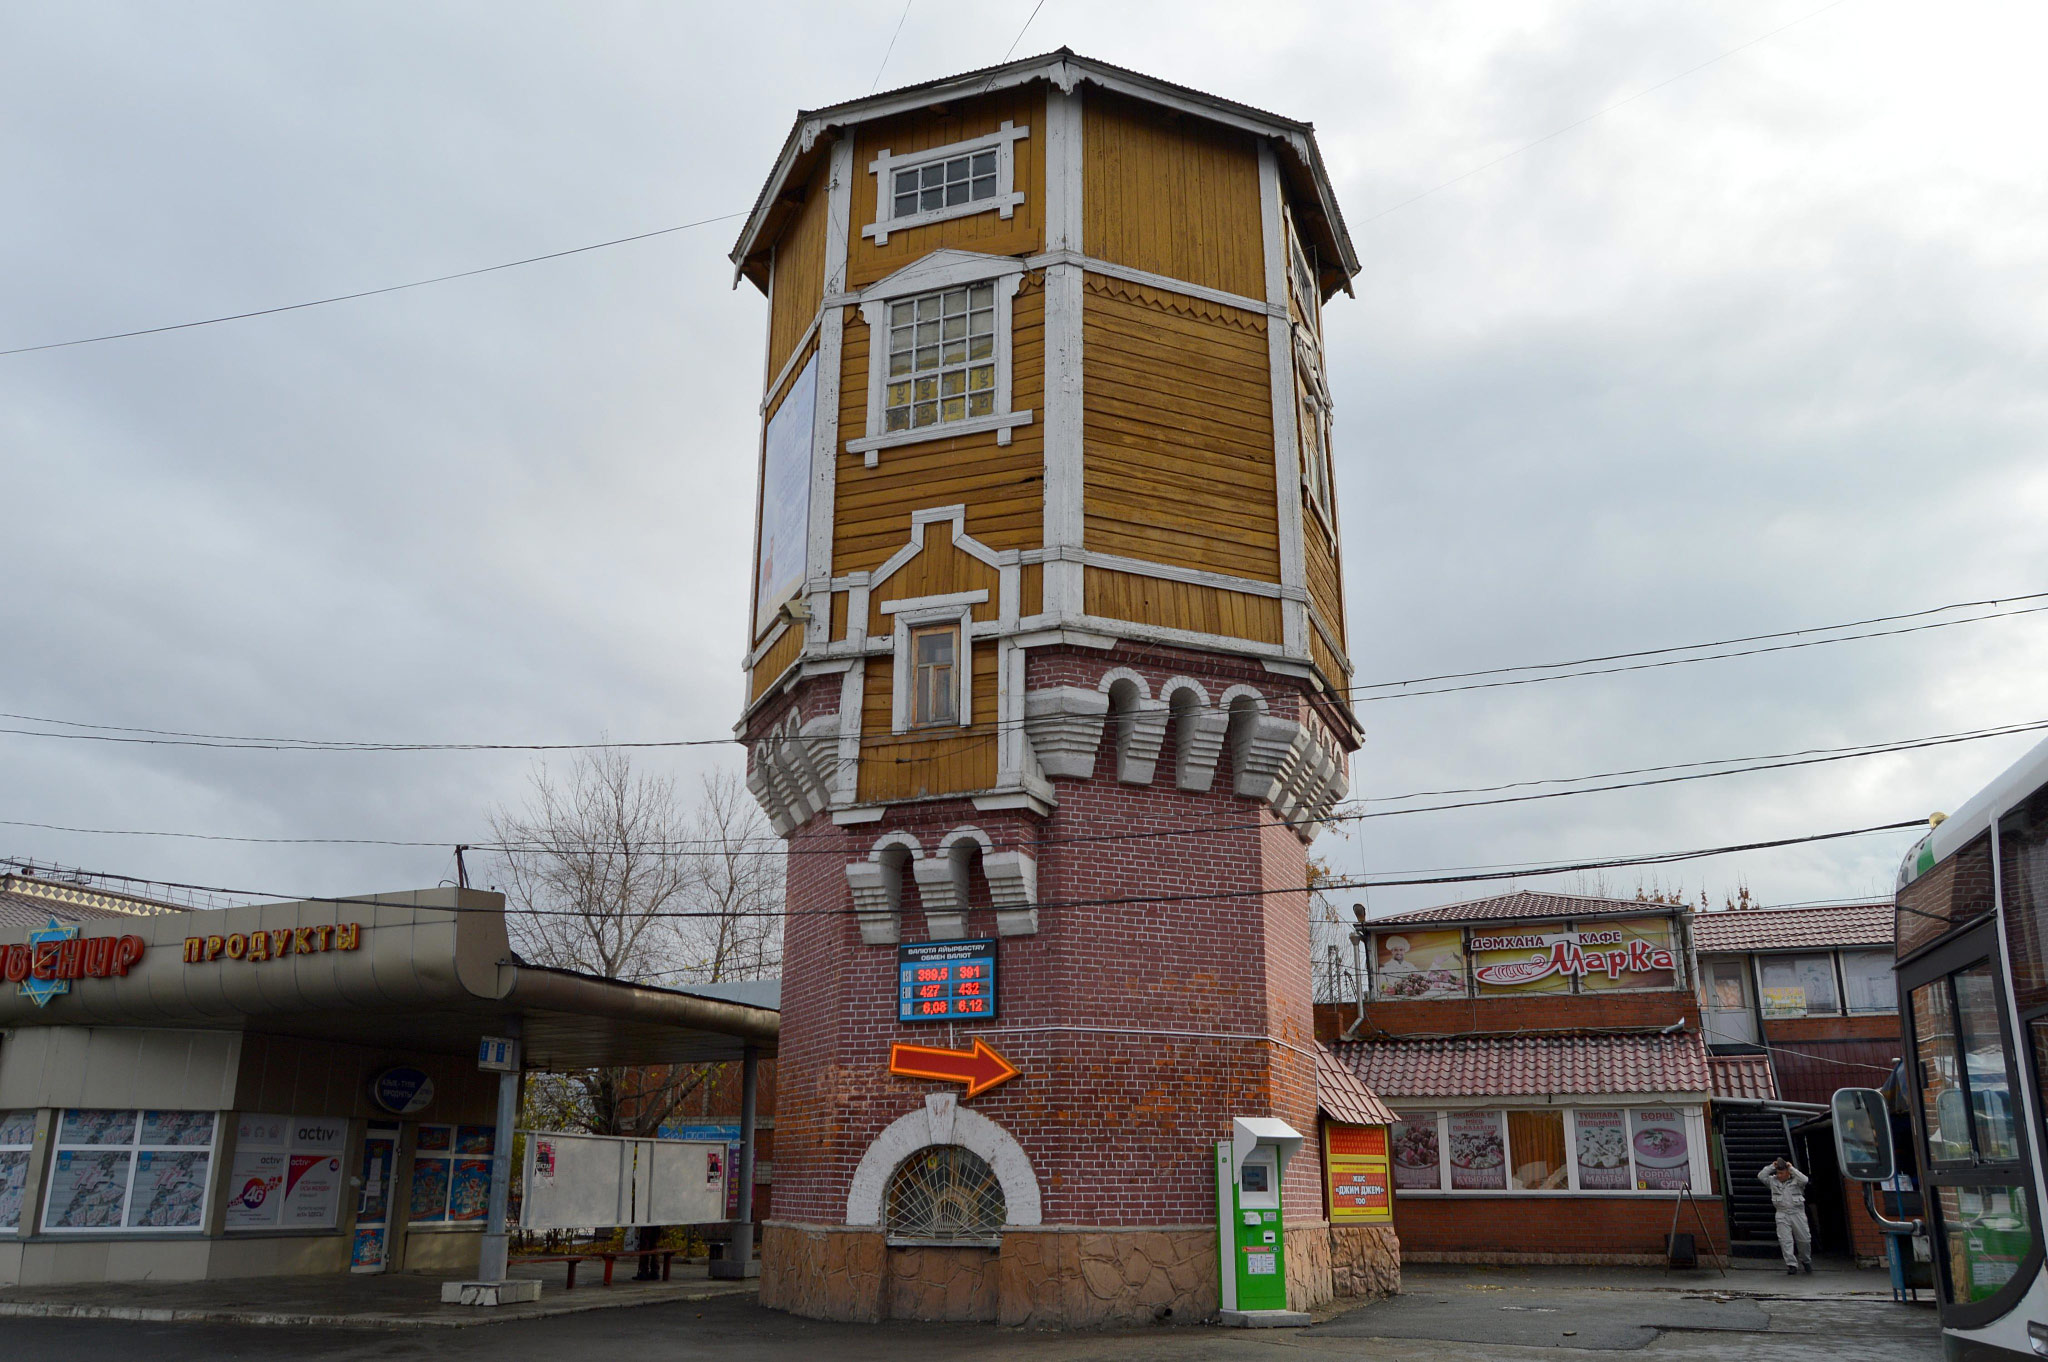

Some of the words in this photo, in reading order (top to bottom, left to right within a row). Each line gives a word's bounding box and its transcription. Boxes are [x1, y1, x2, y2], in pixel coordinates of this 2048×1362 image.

[184, 922, 360, 963] ПРОДУКТЫ
[1471, 936, 1545, 950] ДӘМХАНА
[1578, 931, 1622, 945] КАФЕ
[908, 947, 937, 955] ВАЛЮТА
[937, 944, 985, 954] АЙЫРБАСТАУ
[946, 952, 972, 960] ВАЛЮТ
[0, 934, 145, 983] ВЕНИР
[959, 965, 980, 979] 391
[920, 984, 940, 998] 427
[959, 982, 979, 995] 432
[958, 999, 983, 1013] 6,12
[1641, 1112, 1676, 1121] БОРЩ
[298, 1126, 334, 1141] activ
[260, 1155, 280, 1165] activ
[1585, 1174, 1625, 1185] МАНТЫ
[1639, 1170, 1671, 1179] СОРПА
[243, 1185, 264, 1203] 4G
[1355, 1197, 1366, 1205] ТОО
